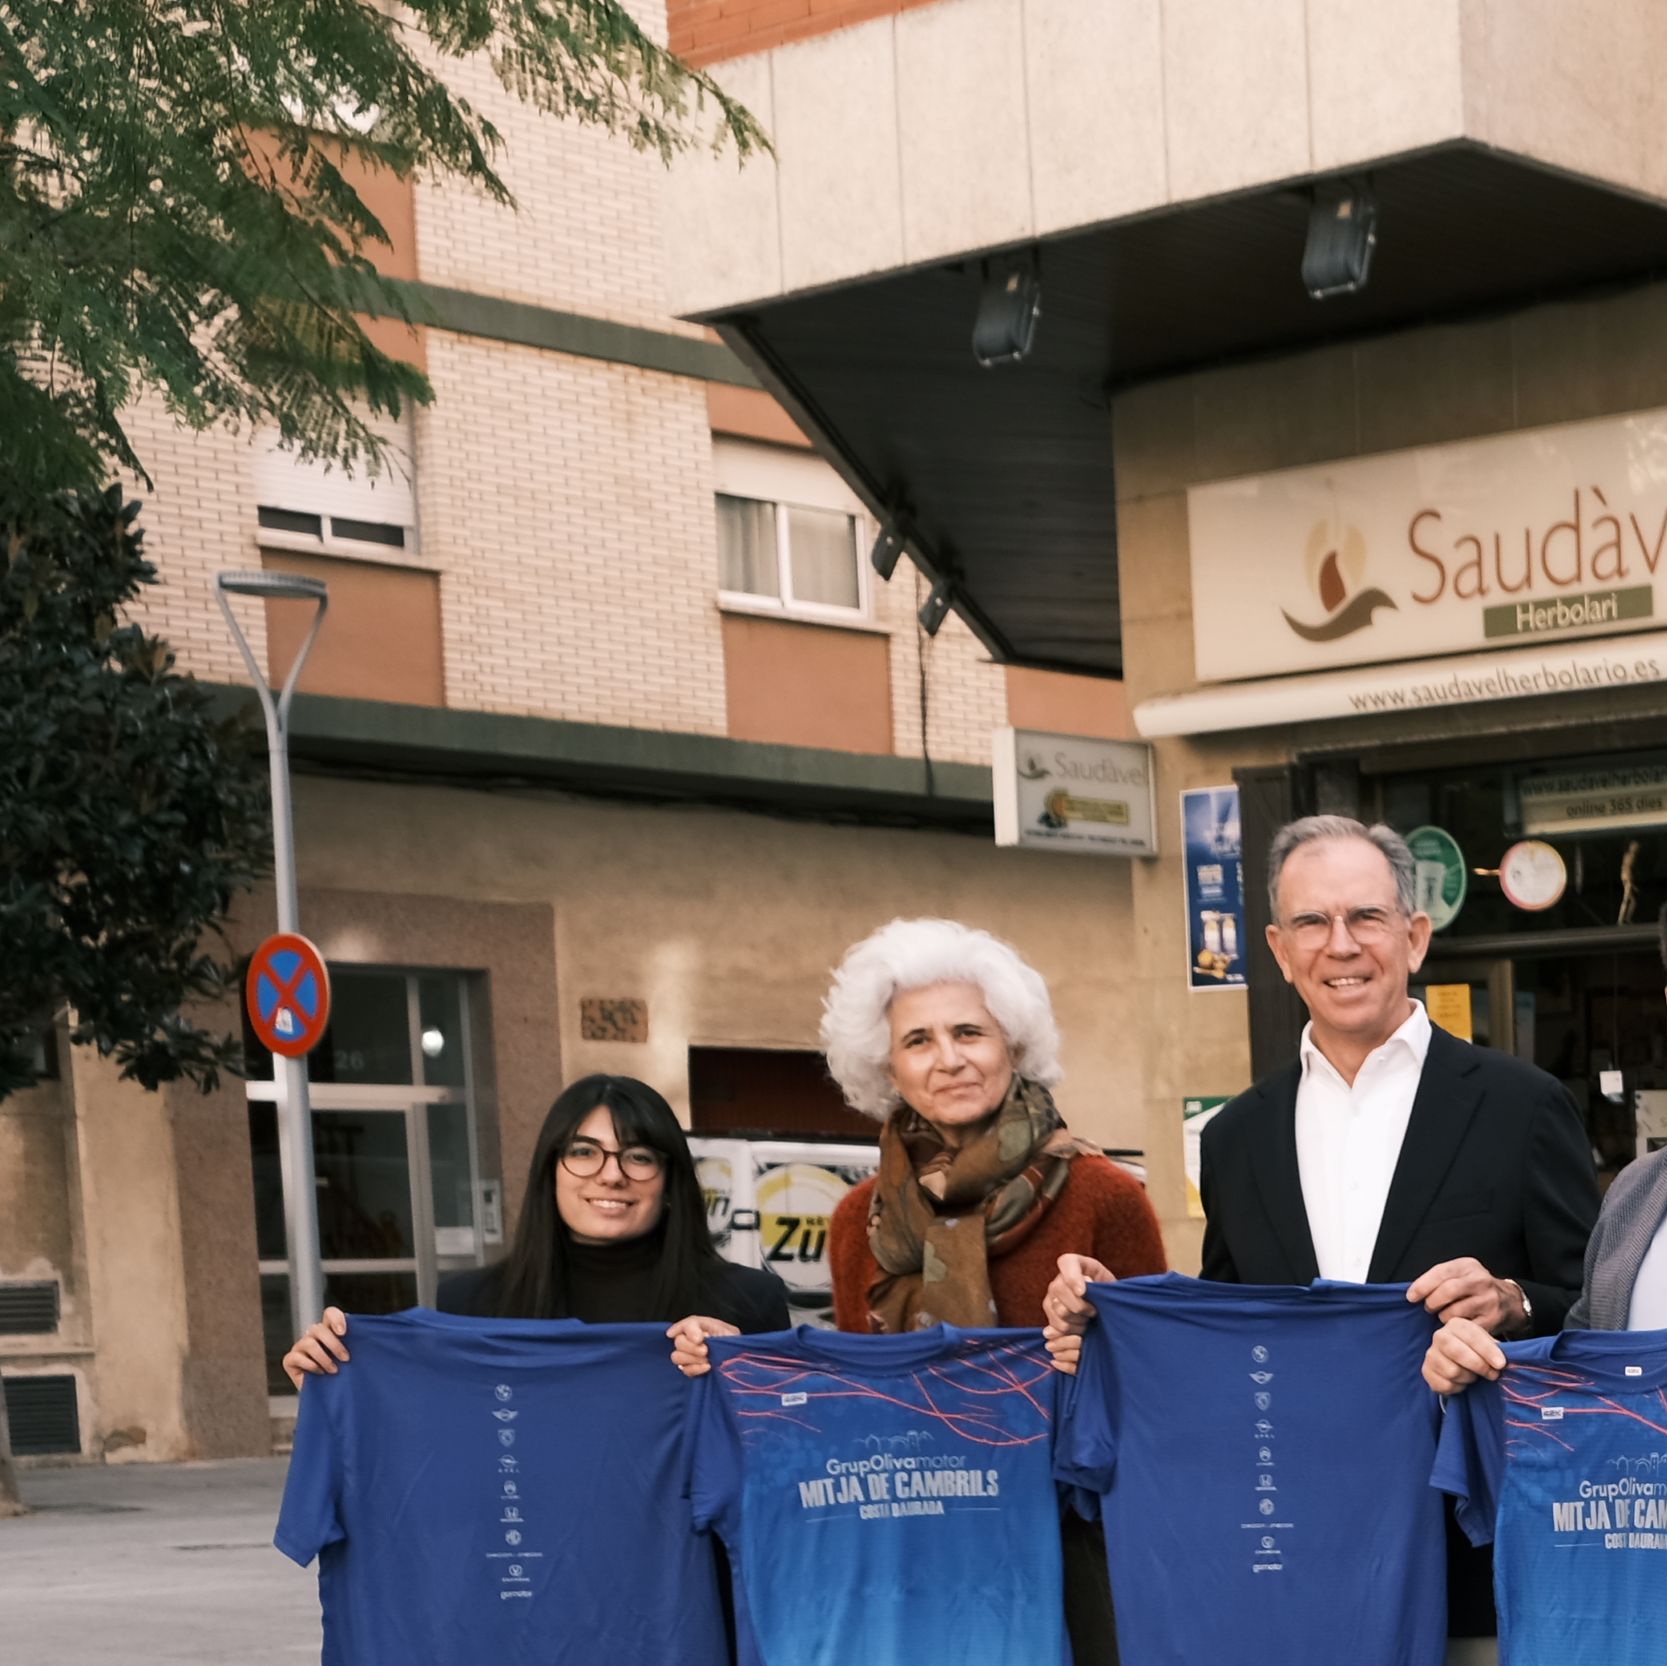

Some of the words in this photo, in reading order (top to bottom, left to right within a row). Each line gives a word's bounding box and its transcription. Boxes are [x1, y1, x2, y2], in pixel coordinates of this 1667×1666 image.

[1515, 592, 1618, 632] Herbolari
[1349, 657, 1661, 711] www.saudavelherbolario.es
[1566, 800, 1606, 817] online
[1609, 797, 1633, 815] 365
[826, 1453, 966, 1475] GrupOlivamotor
[799, 1477, 864, 1508] MITJA
[868, 1473, 891, 1501] DE
[894, 1469, 999, 1498] CAMBRILS
[1553, 1500, 1611, 1532] MITJA
